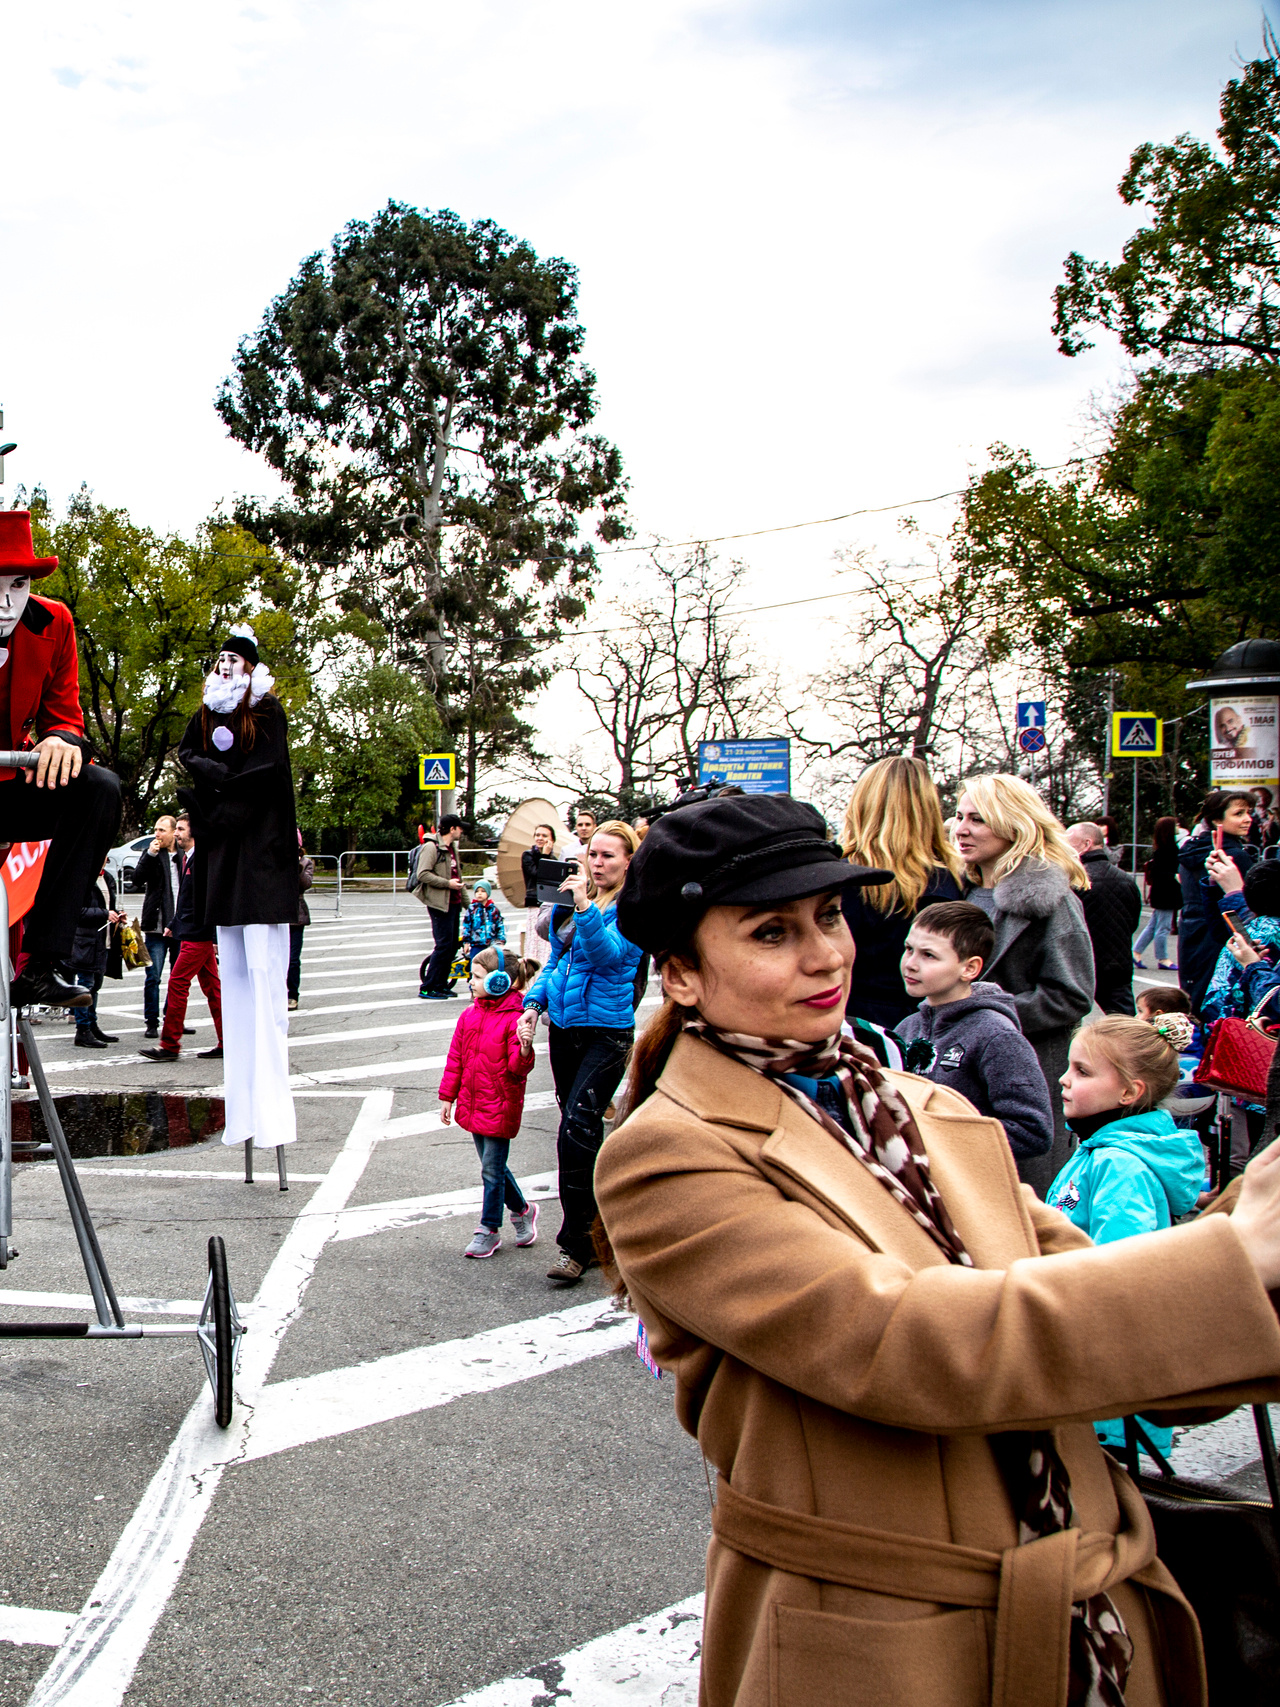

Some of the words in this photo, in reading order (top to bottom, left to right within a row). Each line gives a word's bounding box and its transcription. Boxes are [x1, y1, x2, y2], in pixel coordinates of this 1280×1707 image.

[702, 762, 745, 773] Продукты
[1212, 760, 1274, 770] ТРОФИМОВ
[726, 771, 763, 780] Напитки
